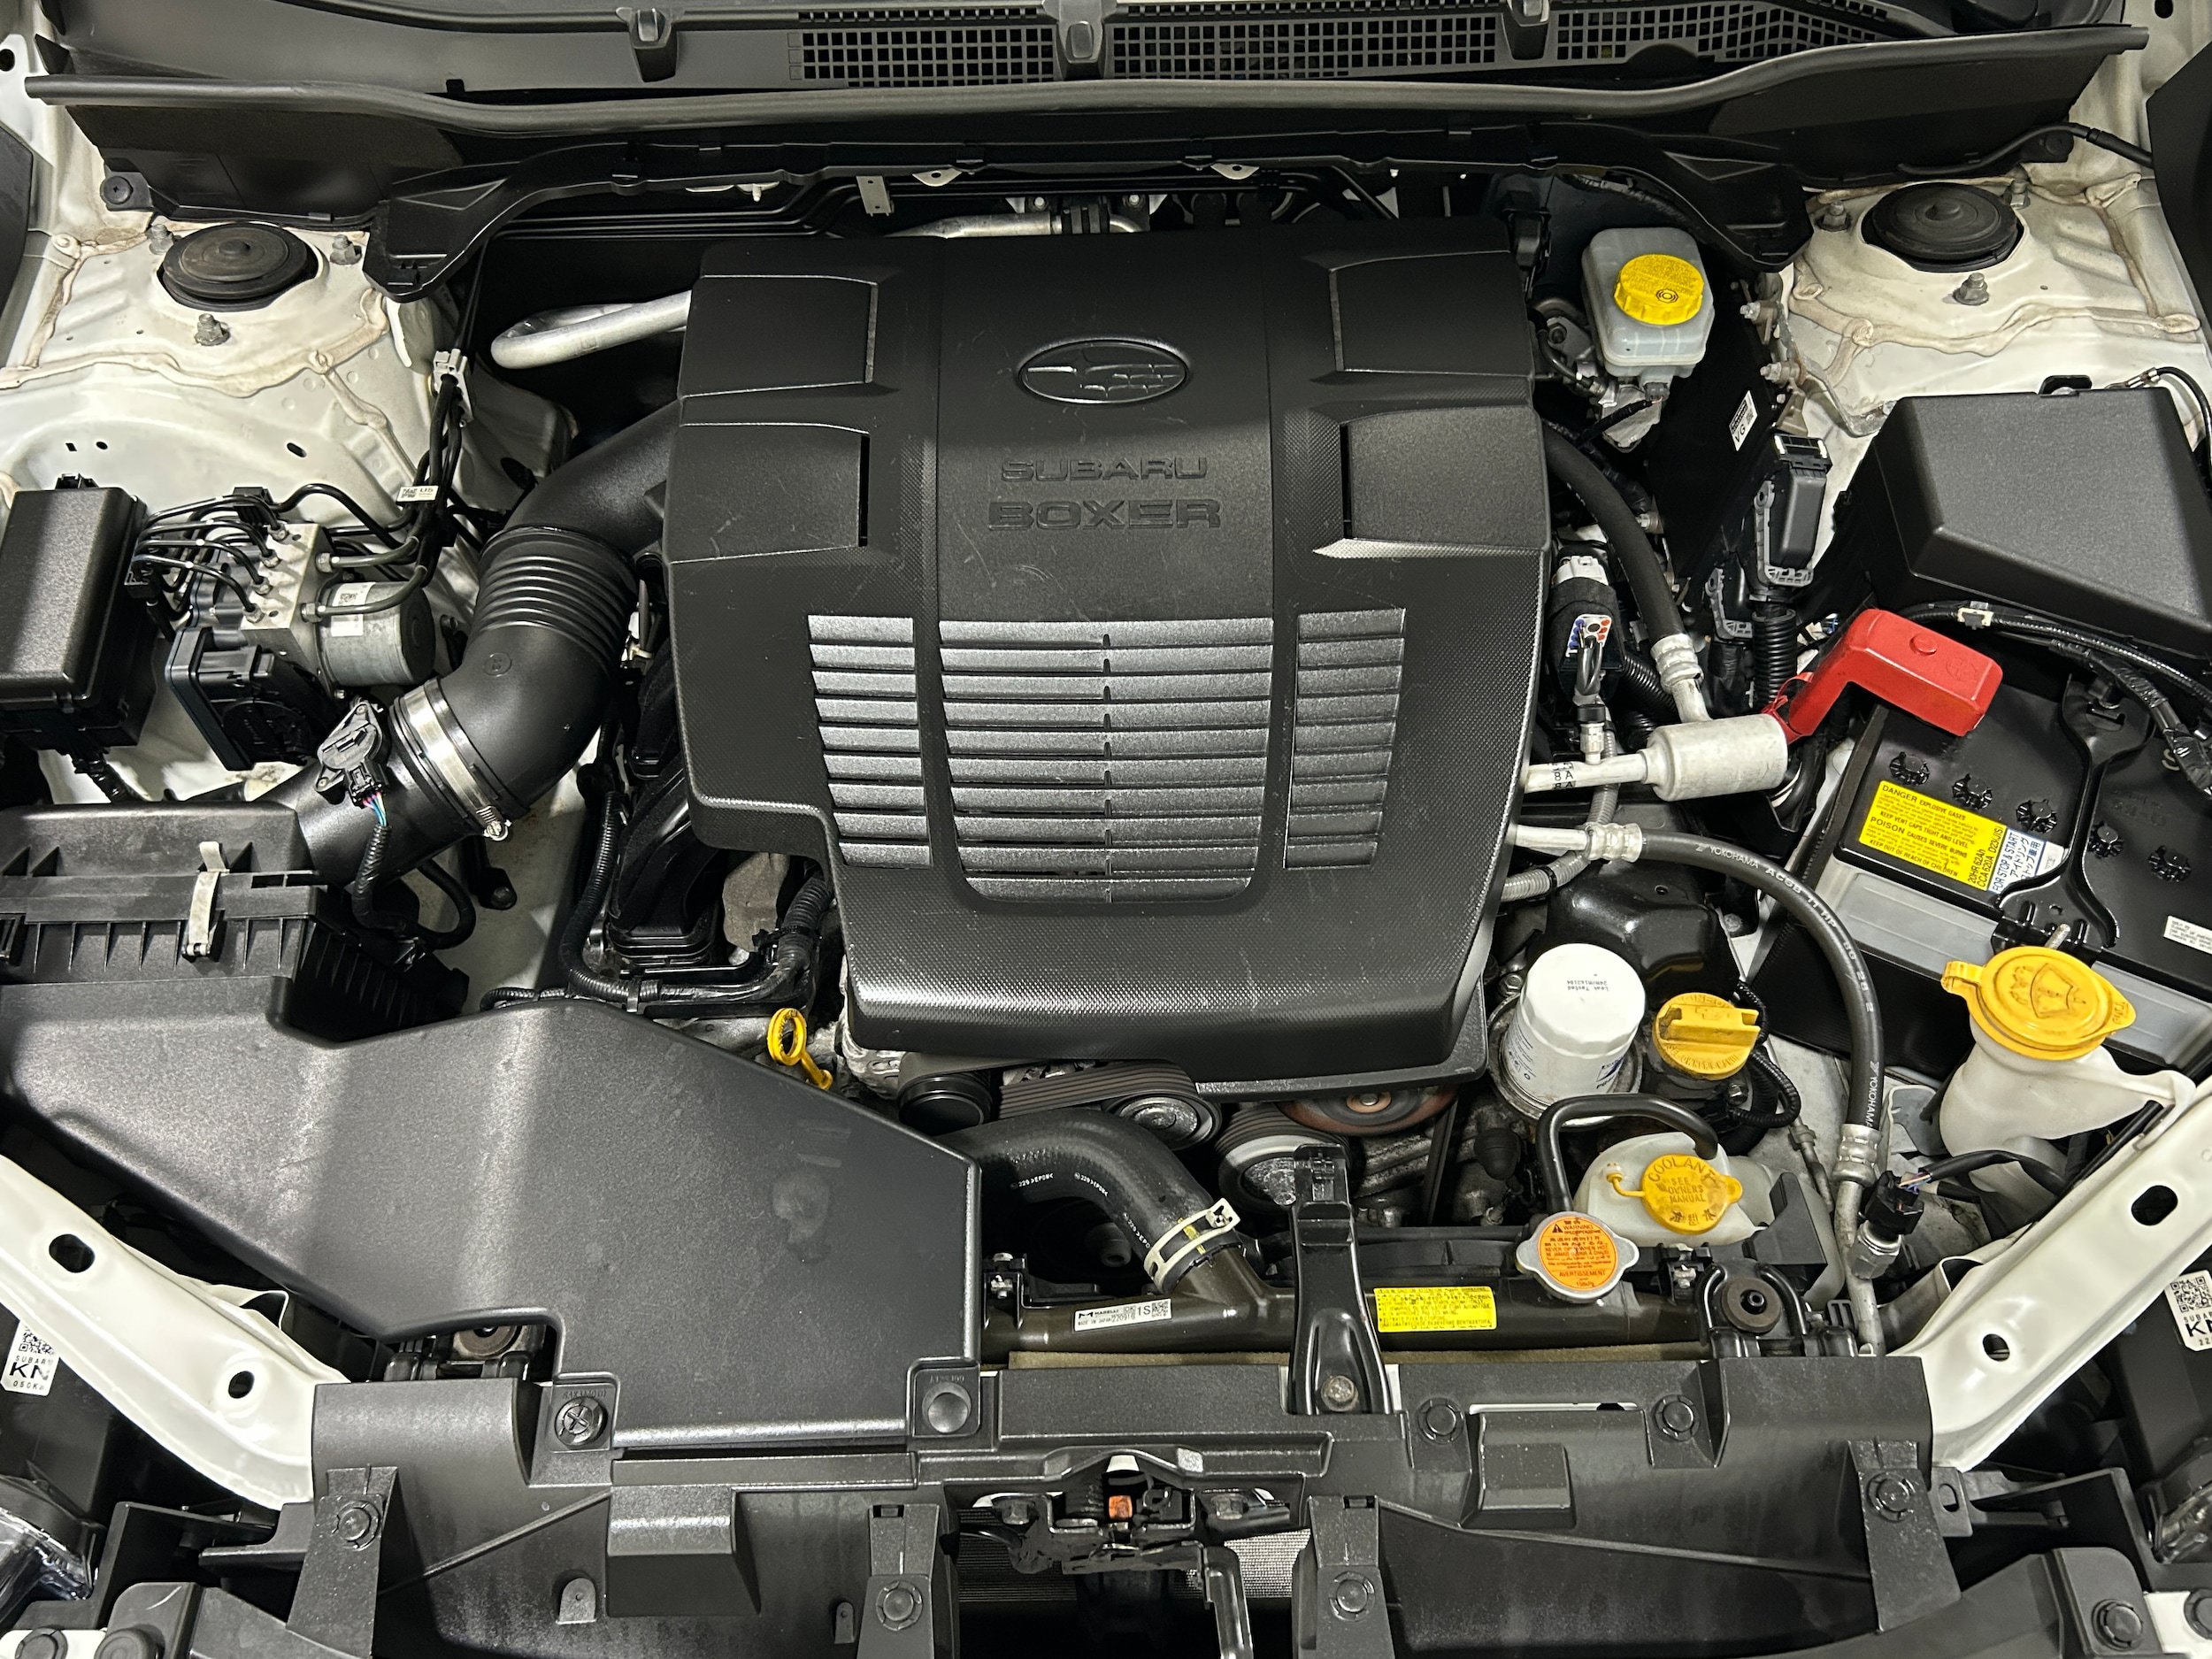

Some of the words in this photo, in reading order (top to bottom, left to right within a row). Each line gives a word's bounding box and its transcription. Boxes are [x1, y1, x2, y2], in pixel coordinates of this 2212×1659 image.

[1002, 457, 1207, 481] SUBARU
[988, 499, 1221, 531] BOXER
[1882, 785, 1917, 803] DANGER
[1919, 800, 1947, 814] EXPLOSIVE
[1948, 810, 1966, 821] GASES
[1870, 816, 1905, 834] POISON
[1907, 832, 1927, 843] CAUSES
[1928, 838, 1948, 851] SEVERE
[1949, 847, 1968, 858] BURNS
[1879, 810, 1893, 819] KEEP
[1894, 816, 1908, 826] VENT
[1909, 821, 1923, 831] CAPS
[1924, 827, 1939, 838] TIGHT
[1939, 833, 1952, 842] AND
[1953, 838, 1969, 849] LEVEL
[2005, 832, 2019, 855] START
[1709, 845, 1760, 869] YOKOHAMA
[1870, 839, 1884, 849] KEEP
[1884, 843, 1894, 854] OUT
[1903, 852, 1923, 862] REACH
[1931, 861, 1958, 877] CHILDREN
[1967, 865, 1979, 884] 20HR
[1974, 849, 1986, 865] 62Ah
[1982, 856, 1994, 872] 620A
[1998, 859, 2010, 877] STOP
[2009, 837, 2030, 878] アイドリング
[1978, 871, 1989, 887] CCA
[1993, 876, 2004, 892] FOR
[1647, 1156, 1717, 1189] COOLANT
[1671, 1177, 1689, 1186] SEE
[1670, 1194, 1706, 1203] MANUAL
